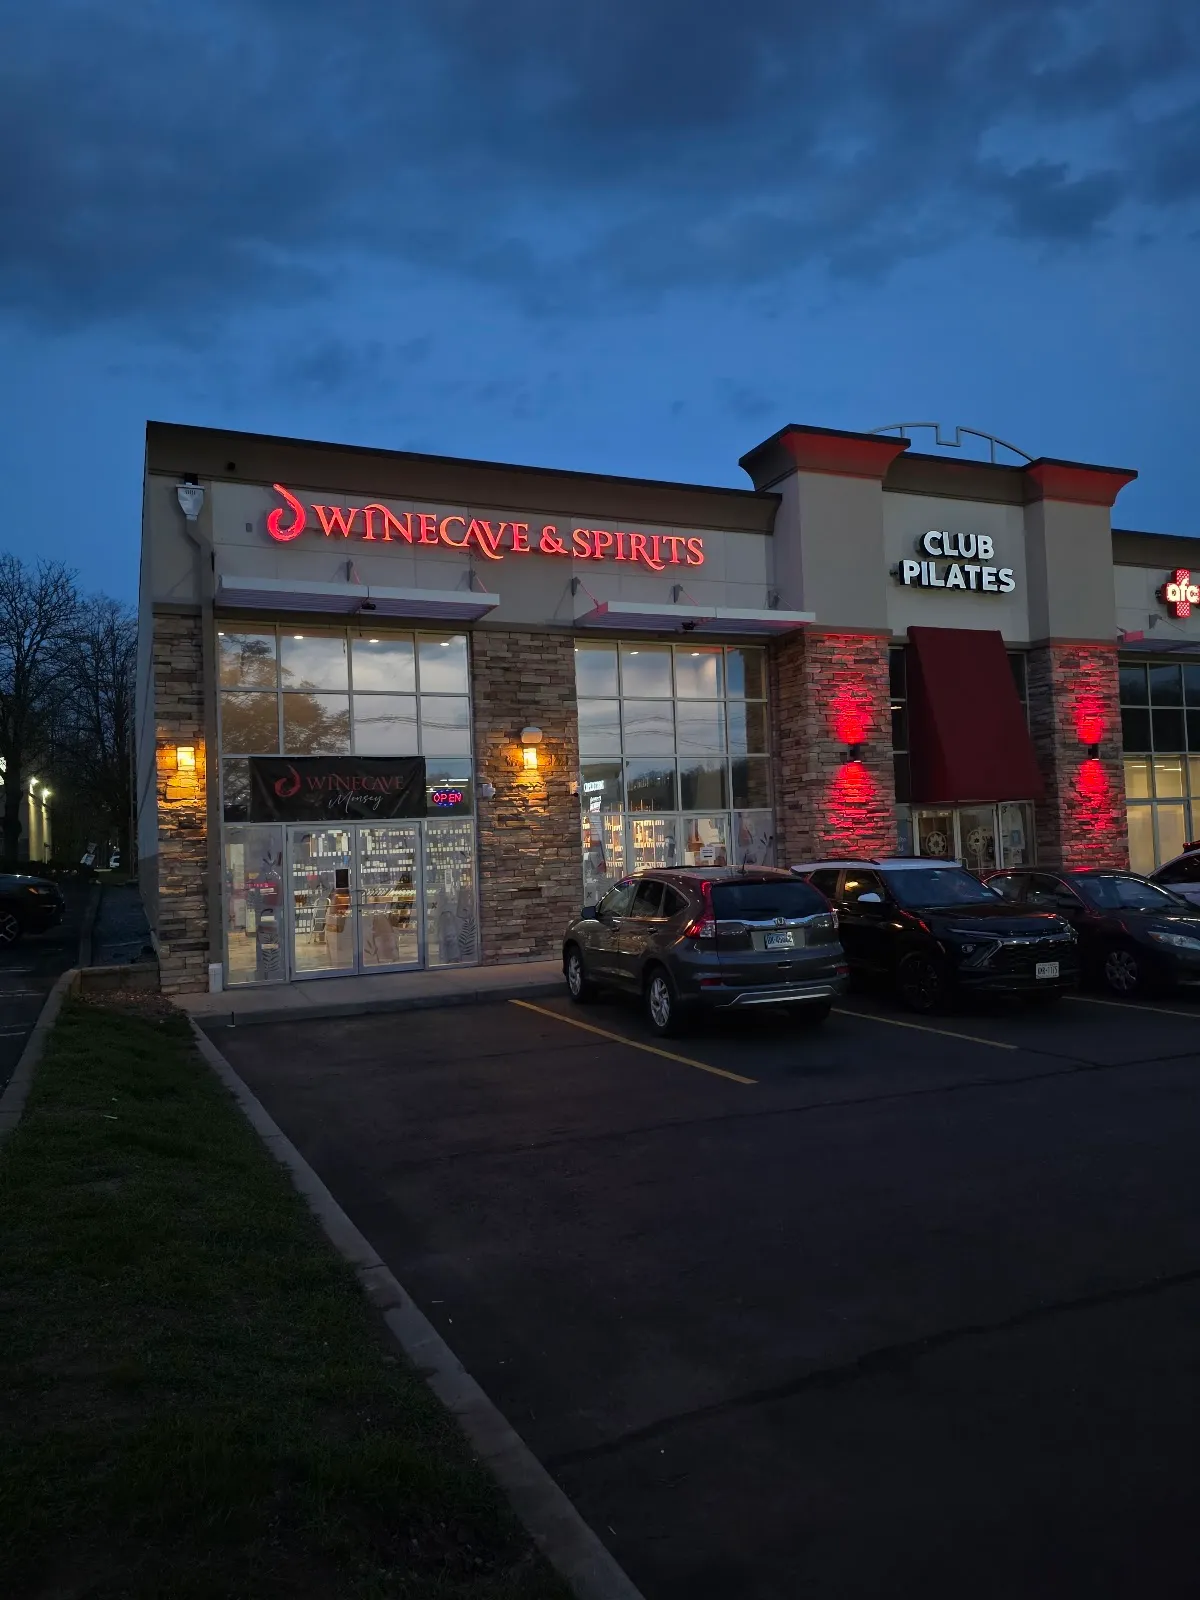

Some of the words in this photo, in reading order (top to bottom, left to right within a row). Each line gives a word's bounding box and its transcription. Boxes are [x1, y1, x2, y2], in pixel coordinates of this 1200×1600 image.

[311, 503, 530, 560] WINECAVE
[539, 525, 568, 554] &
[572, 528, 704, 571] SPIRITS
[923, 530, 995, 560] CLUB
[902, 559, 1016, 593] PILATES
[306, 773, 405, 795] WINECAVE
[433, 792, 463, 803] OPEN
[327, 790, 384, 814] Monsey
